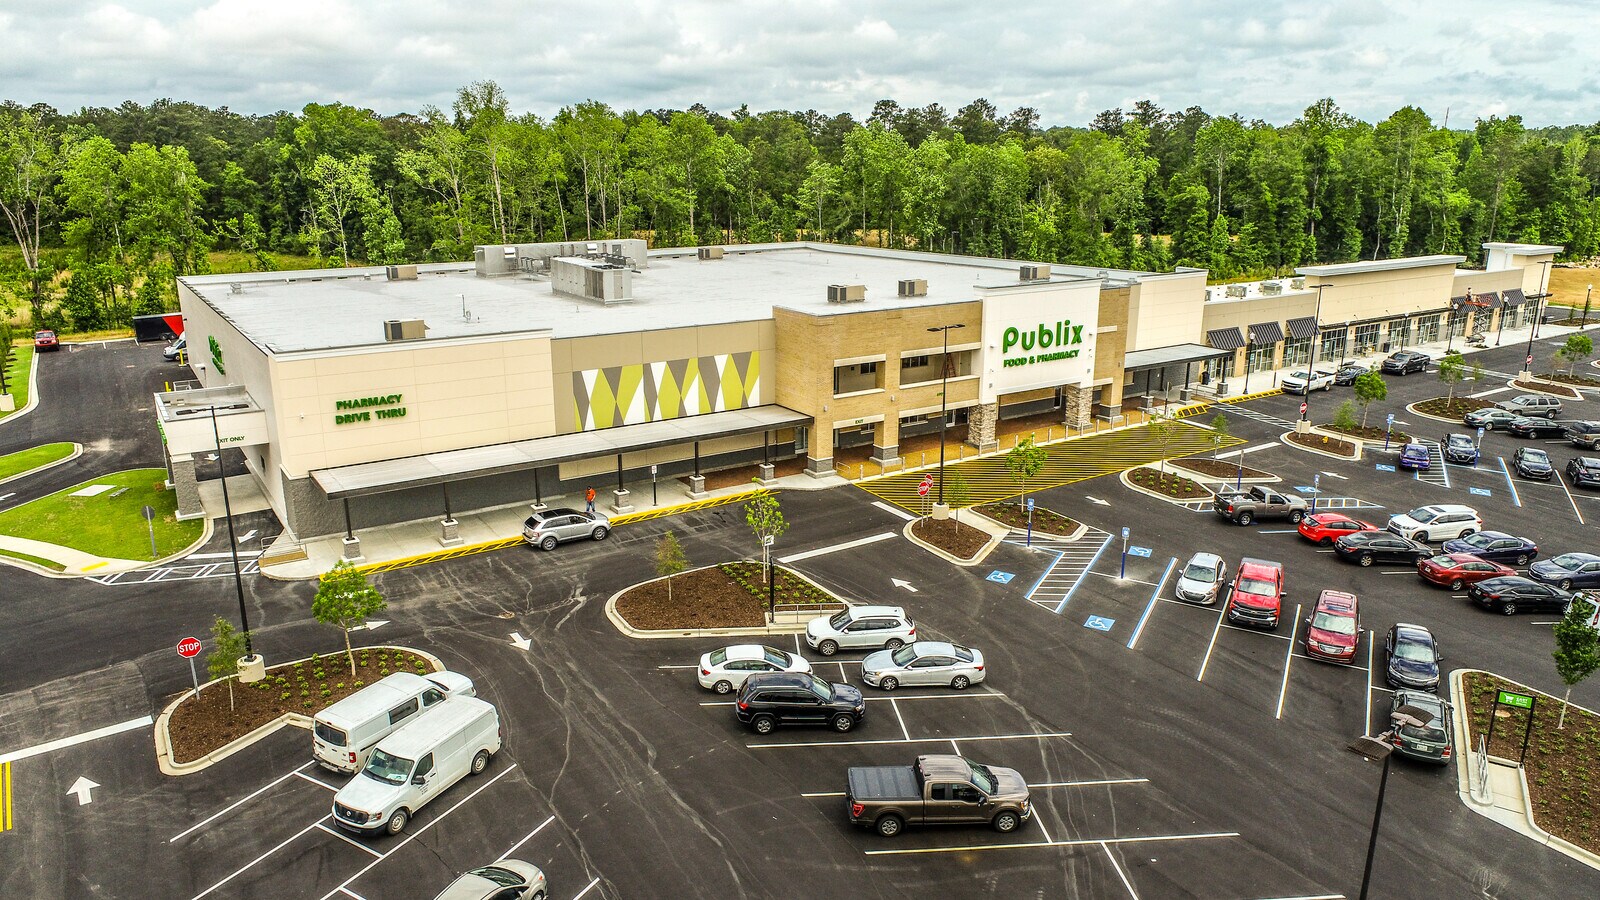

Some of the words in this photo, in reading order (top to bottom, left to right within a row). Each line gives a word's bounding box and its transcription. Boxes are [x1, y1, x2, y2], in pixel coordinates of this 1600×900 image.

[1002, 319, 1084, 354] Publix
[1003, 357, 1027, 367] FOOD
[1029, 356, 1035, 364] &
[1037, 349, 1080, 363] PHARMACY
[336, 394, 402, 410] PHARMACY
[335, 411, 370, 424] DRIVE
[375, 407, 406, 419] THRU
[179, 642, 200, 653] STOP
